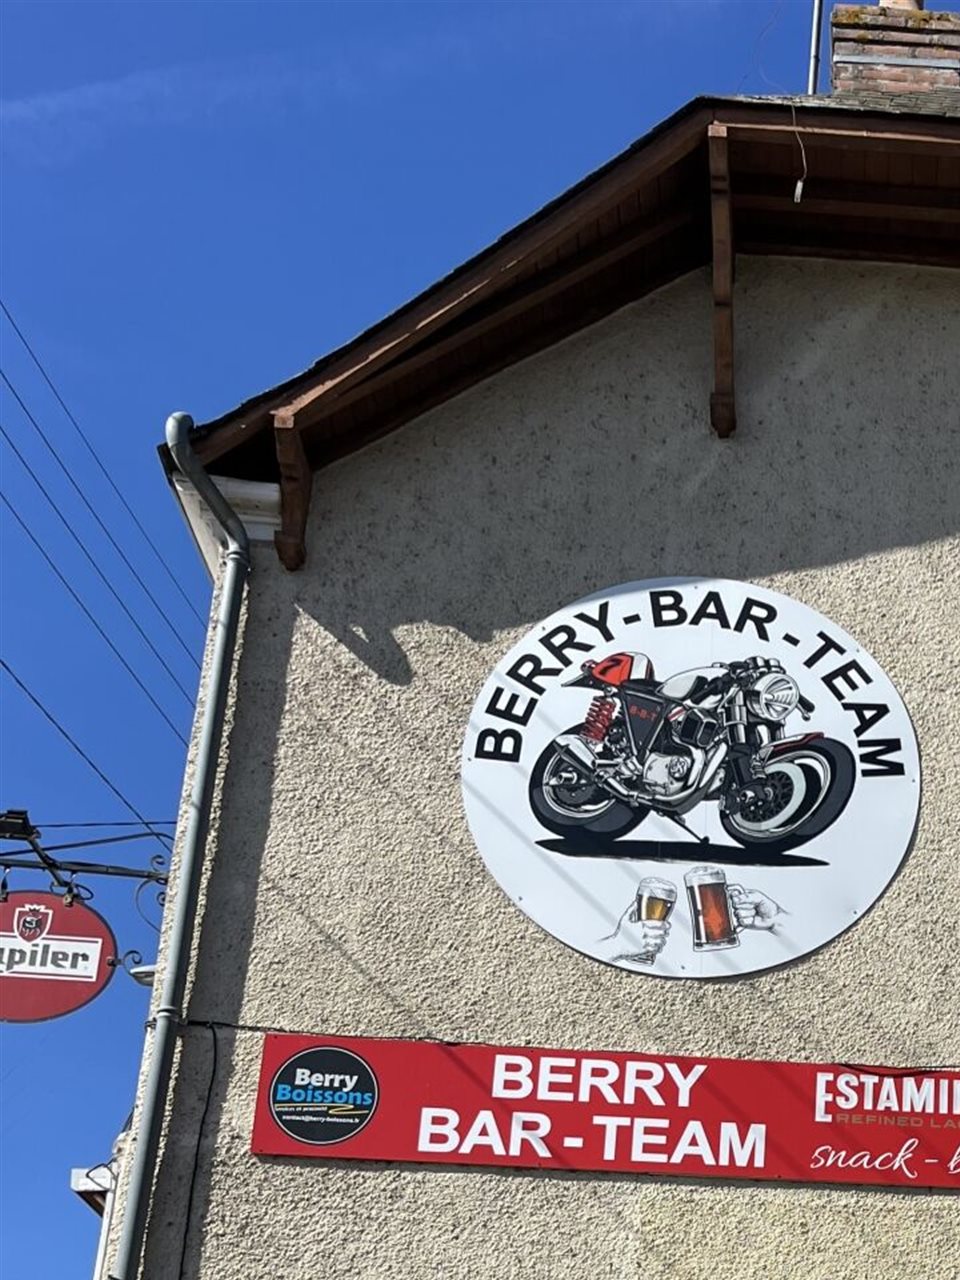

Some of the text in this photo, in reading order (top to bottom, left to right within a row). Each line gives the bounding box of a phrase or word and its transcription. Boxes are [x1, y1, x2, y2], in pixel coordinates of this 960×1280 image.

[294, 1068, 358, 1092] Berry
[492, 1053, 708, 1107] BERRY
[276, 1084, 373, 1105] Boissons
[836, 1113, 924, 1127] REFINED
